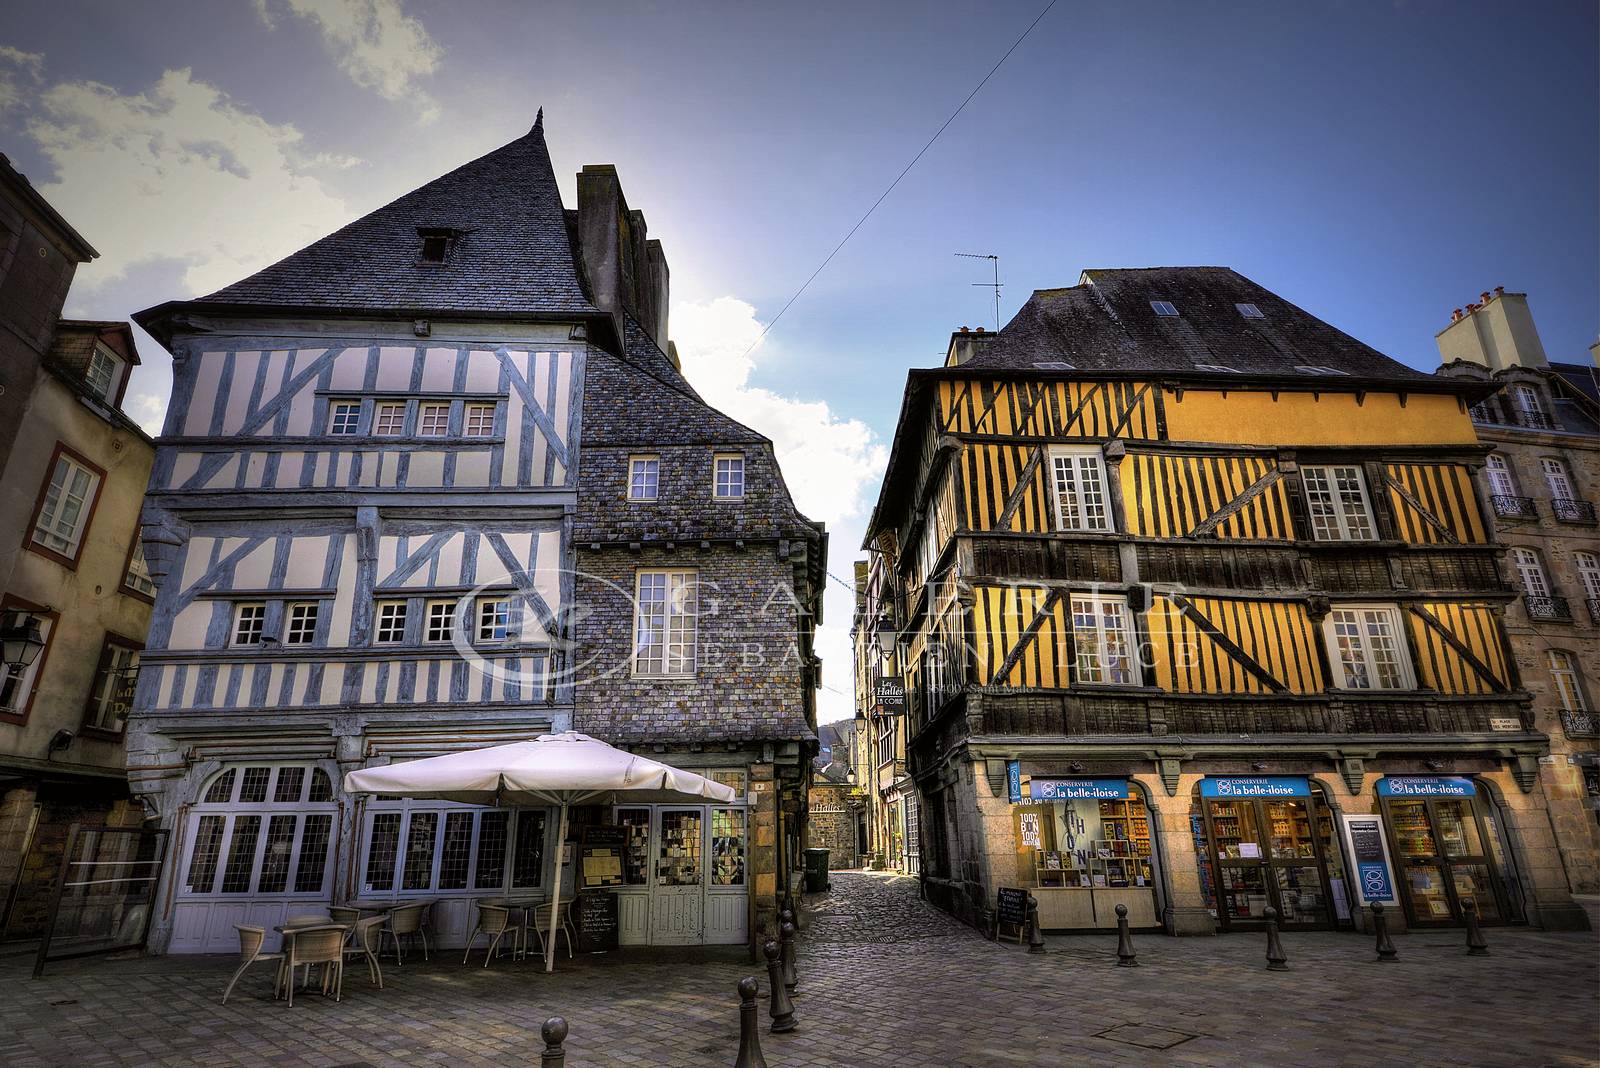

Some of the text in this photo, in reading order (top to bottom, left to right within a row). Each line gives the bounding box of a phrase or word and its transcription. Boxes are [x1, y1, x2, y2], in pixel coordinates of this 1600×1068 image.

[877, 685, 903, 695] Halles
[1057, 788, 1119, 798] la belle-iloise
[1233, 785, 1294, 795] la belle-iloise
[1404, 784, 1464, 794] la belle-iloise
